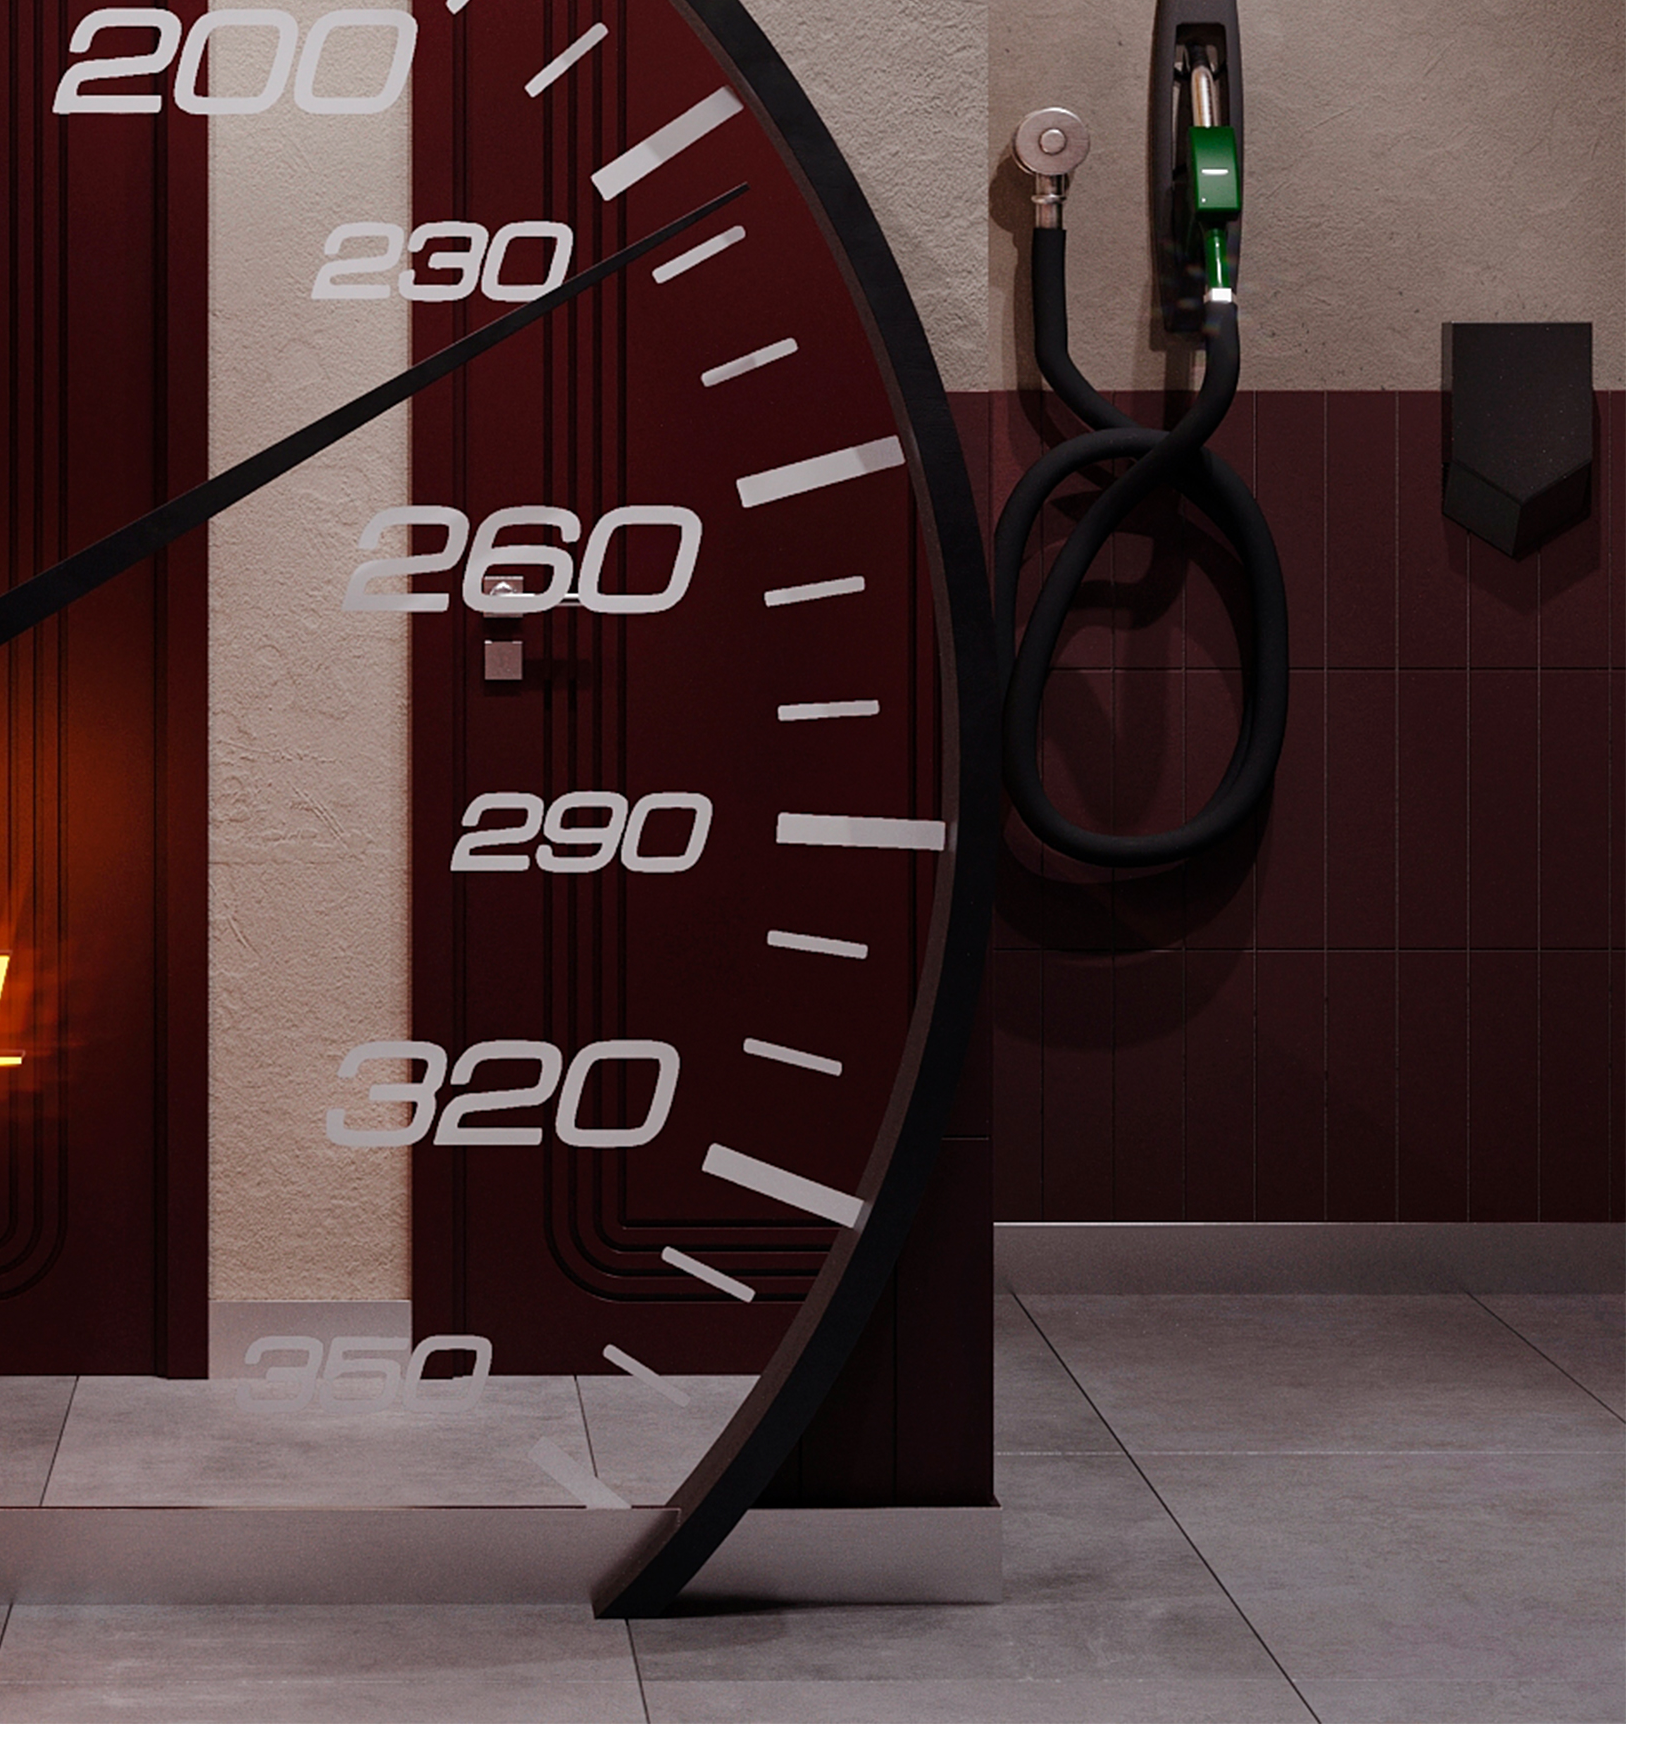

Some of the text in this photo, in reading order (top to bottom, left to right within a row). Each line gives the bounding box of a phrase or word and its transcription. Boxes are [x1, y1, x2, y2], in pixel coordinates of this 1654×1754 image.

[52, 8, 418, 114] 200
[311, 221, 573, 301] 230
[343, 505, 702, 614] 260
[450, 791, 712, 873] 290
[325, 1040, 680, 1147] 320
[234, 1335, 493, 1414] 350
